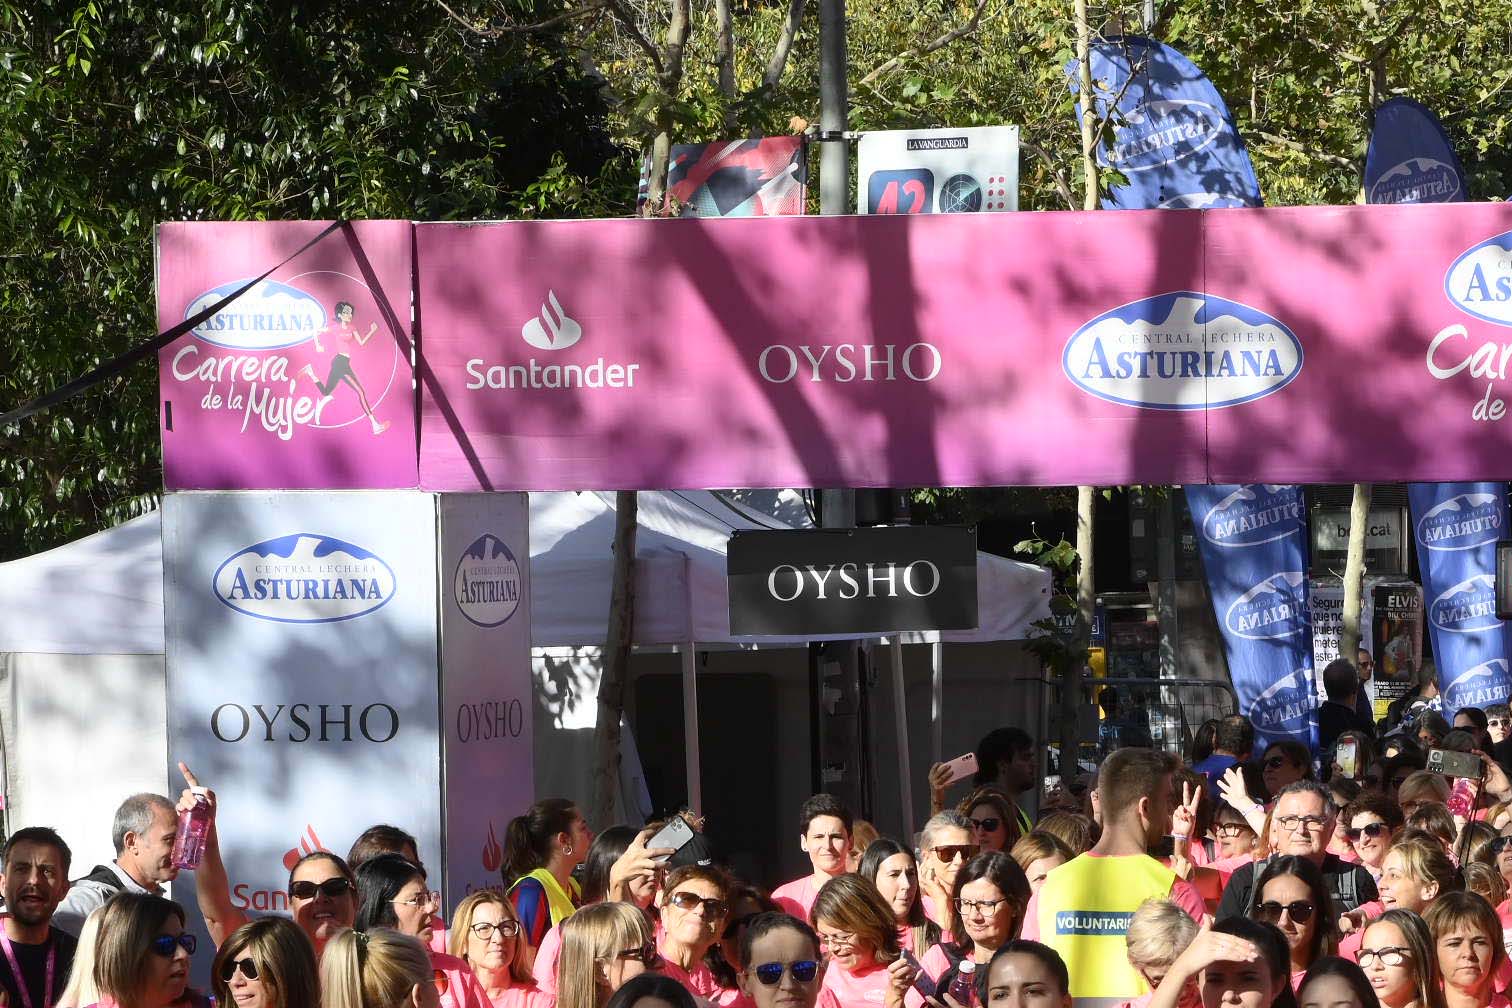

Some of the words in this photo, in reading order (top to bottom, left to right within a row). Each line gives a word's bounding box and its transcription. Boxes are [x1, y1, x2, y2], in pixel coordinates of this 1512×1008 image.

[908, 141, 919, 149] LA
[919, 138, 967, 149] VANGUARDIA
[1118, 332, 1192, 345] CENTRAL
[172, 345, 289, 383] Carrera
[465, 359, 640, 391] Santander
[758, 343, 942, 384] OYSHO
[1081, 337, 1285, 380] ASTURIANA
[201, 384, 222, 410] de
[227, 387, 243, 410] la
[240, 380, 334, 440] Mujer
[1472, 383, 1506, 421] de
[227, 567, 384, 601] ASTURIANA
[255, 565, 313, 575] CENTRAL
[319, 563, 376, 574] LECHERA
[460, 569, 518, 604] ASTURIANA
[767, 561, 941, 602] OYSHO
[1388, 595, 1418, 608] ELVIS
[1315, 651, 1334, 662] este
[210, 703, 400, 743] OYSHO
[457, 699, 523, 743] OYSHO
